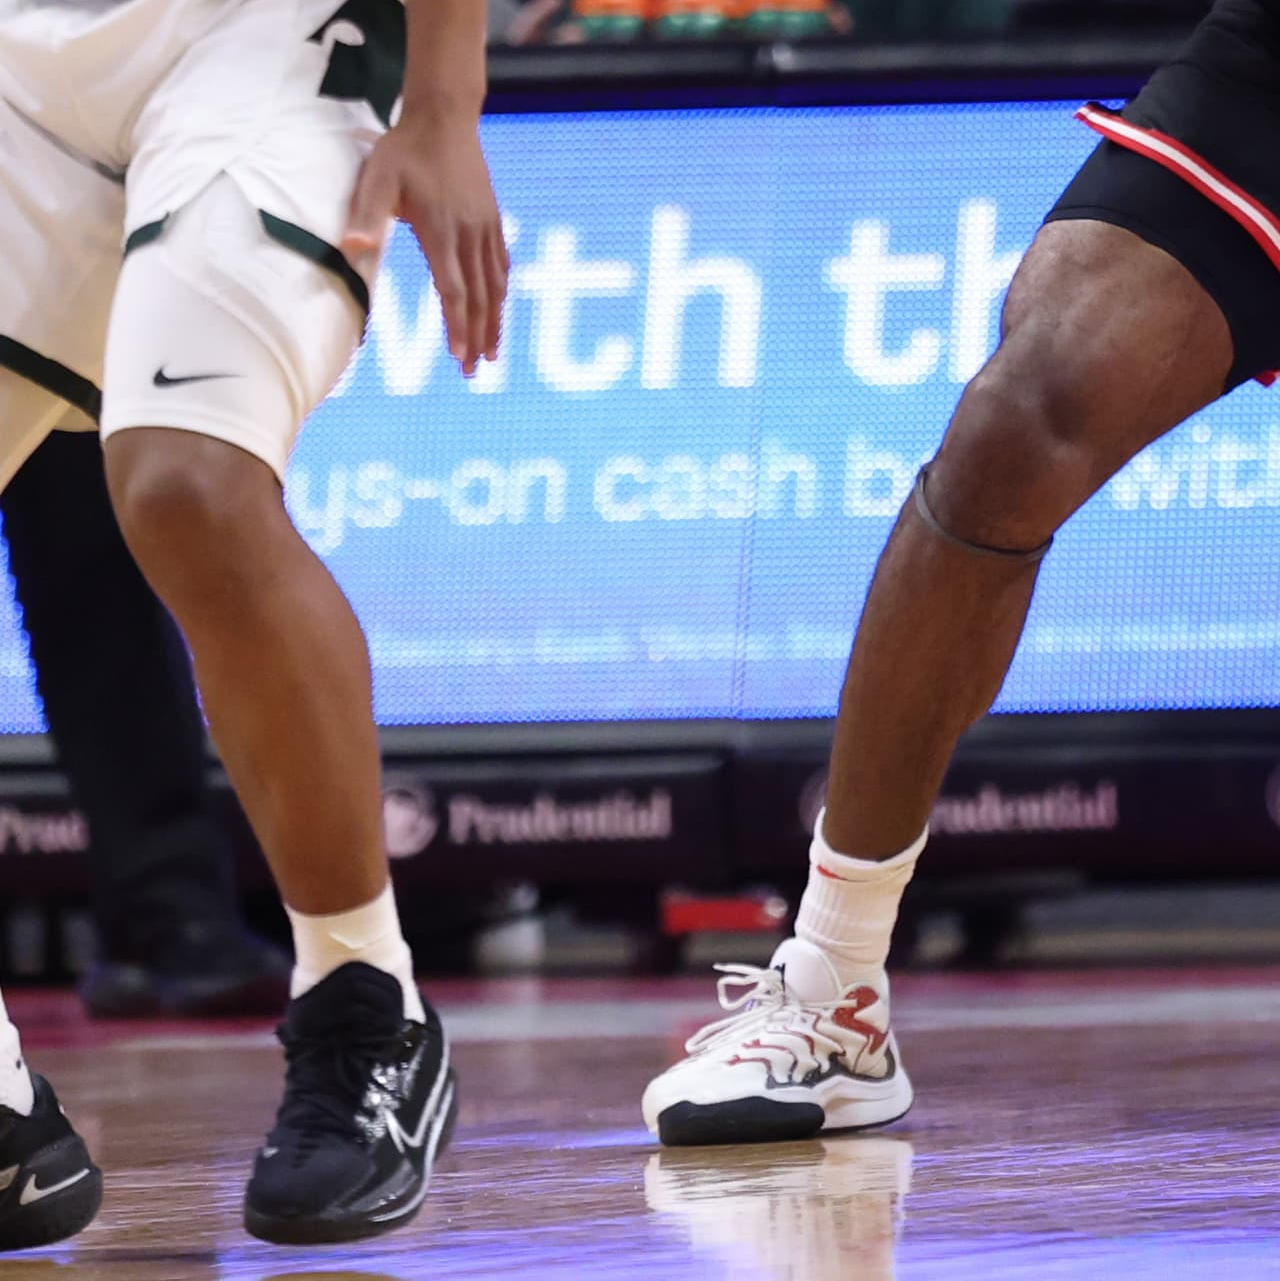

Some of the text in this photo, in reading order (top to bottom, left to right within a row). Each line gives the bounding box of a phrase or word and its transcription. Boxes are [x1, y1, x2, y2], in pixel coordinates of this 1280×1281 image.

[826, 197, 1023, 385] th
[289, 455, 567, 555] ys-on
[592, 437, 817, 523] cash
[447, 790, 672, 846] Prudential
